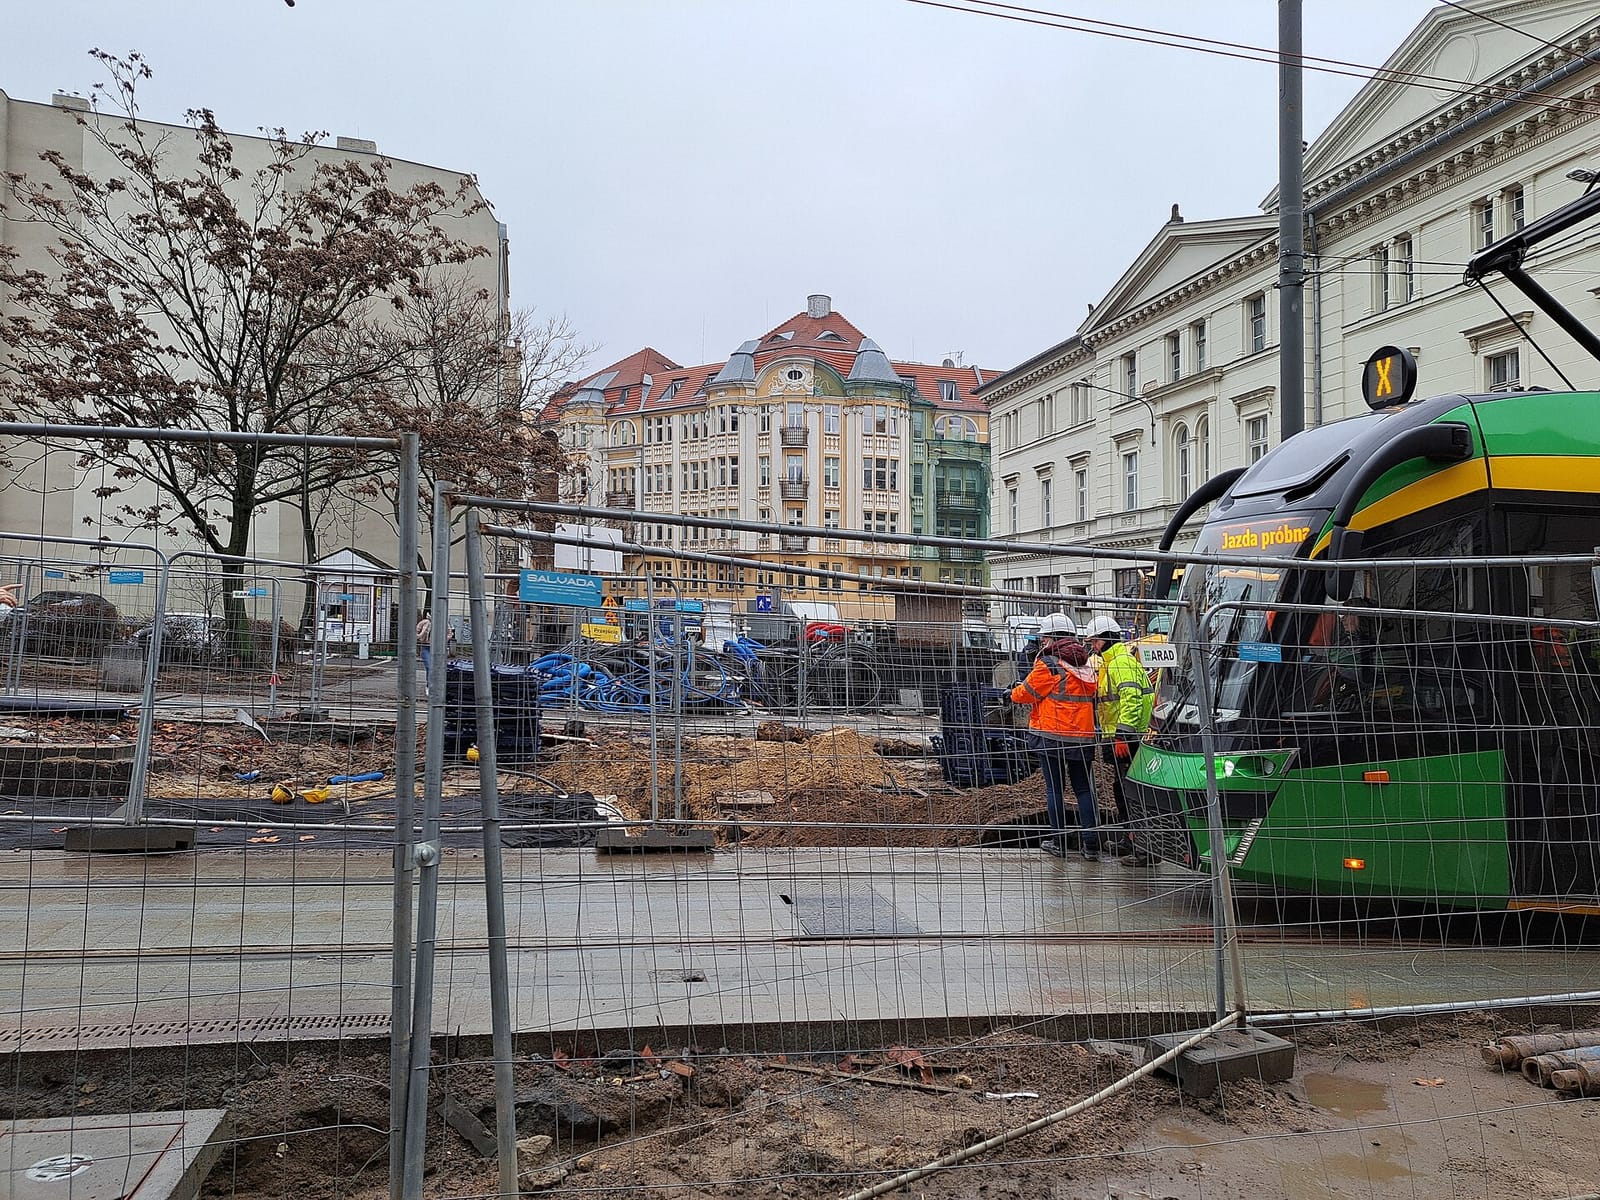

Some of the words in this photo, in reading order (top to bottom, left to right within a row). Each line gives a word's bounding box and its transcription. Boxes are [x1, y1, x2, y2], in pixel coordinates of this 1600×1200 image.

[1376, 356, 1393, 397] X
[1221, 528, 1259, 551] Jazda
[526, 573, 596, 588] SALVADA
[1151, 650, 1175, 661] ARAD
